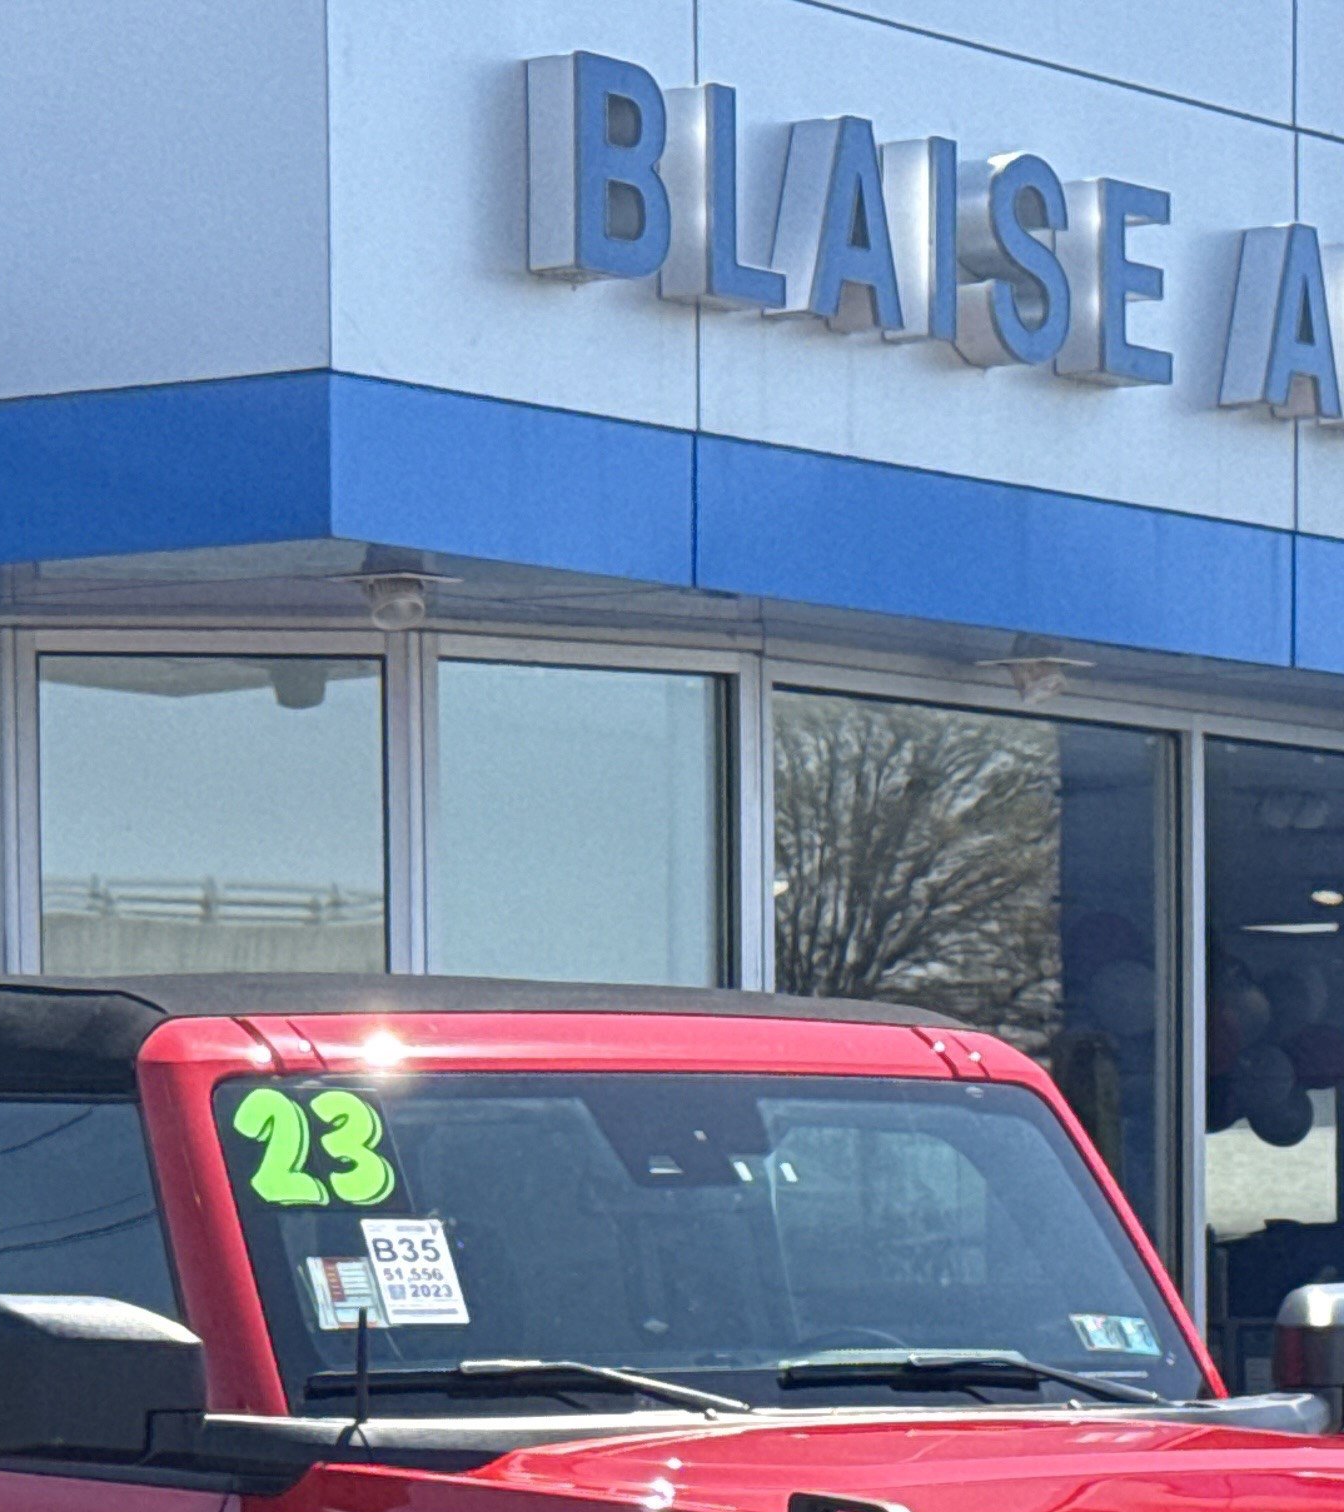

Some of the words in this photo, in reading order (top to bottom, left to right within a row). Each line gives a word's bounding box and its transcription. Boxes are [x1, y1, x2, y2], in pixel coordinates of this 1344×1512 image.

[566, 50, 1174, 387] BLAISE
[233, 1088, 395, 1206] 23
[372, 1238, 441, 1263] B35
[409, 1284, 453, 1298] 2023
